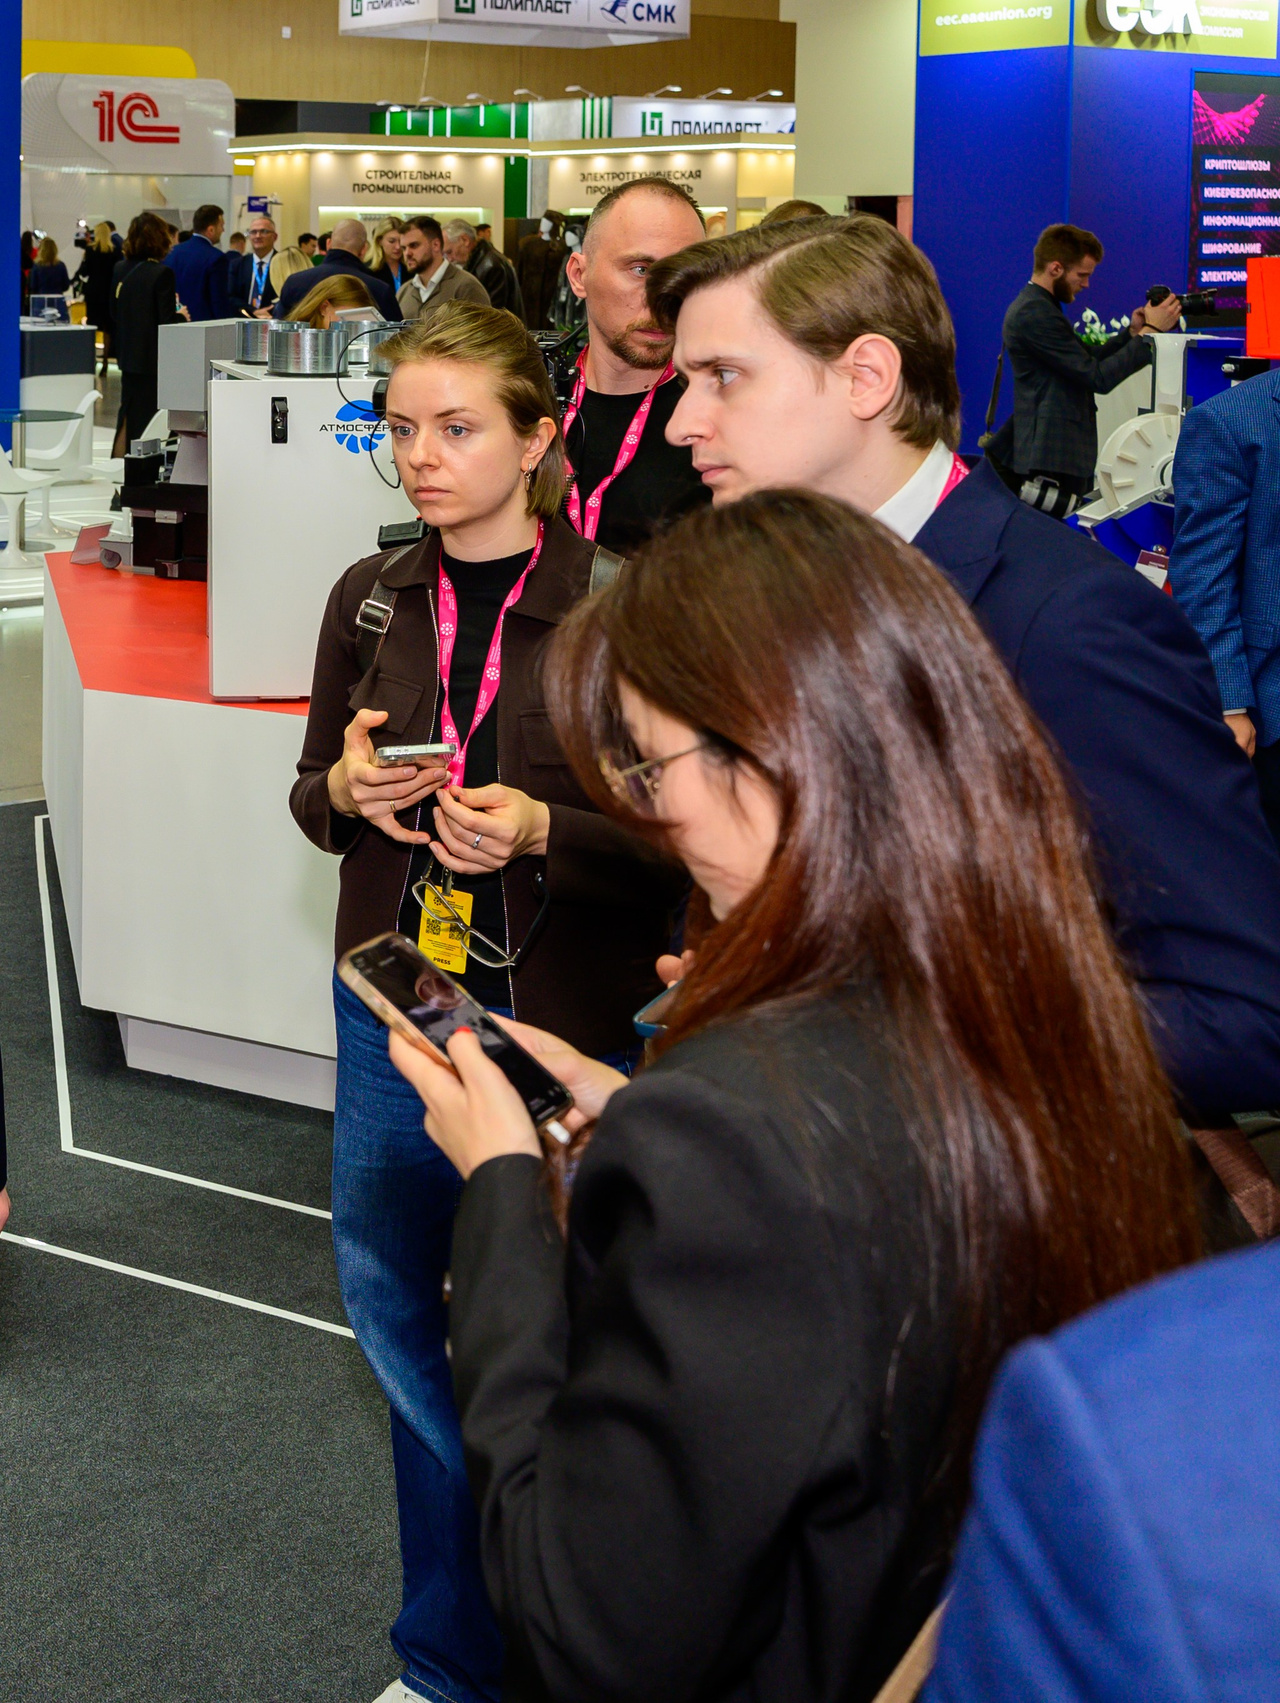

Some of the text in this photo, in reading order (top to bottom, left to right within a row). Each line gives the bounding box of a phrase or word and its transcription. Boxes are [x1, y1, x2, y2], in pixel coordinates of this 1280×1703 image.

[632, 2, 676, 24] СМК
[1204, 158, 1271, 172] КРИПТОШЛЮЗЫ
[365, 169, 452, 180] СТРОИТЕЛЬНАЯ
[352, 183, 464, 195] ПРОМЫШЛЕННОСТЬ
[1202, 214, 1280, 229] ИНФОРМАЦИОННА
[1202, 243, 1262, 255] ШИФРОВАНИЕ
[319, 424, 393, 432] АТМОСФЕР
[433, 956, 451, 966] PRESS
